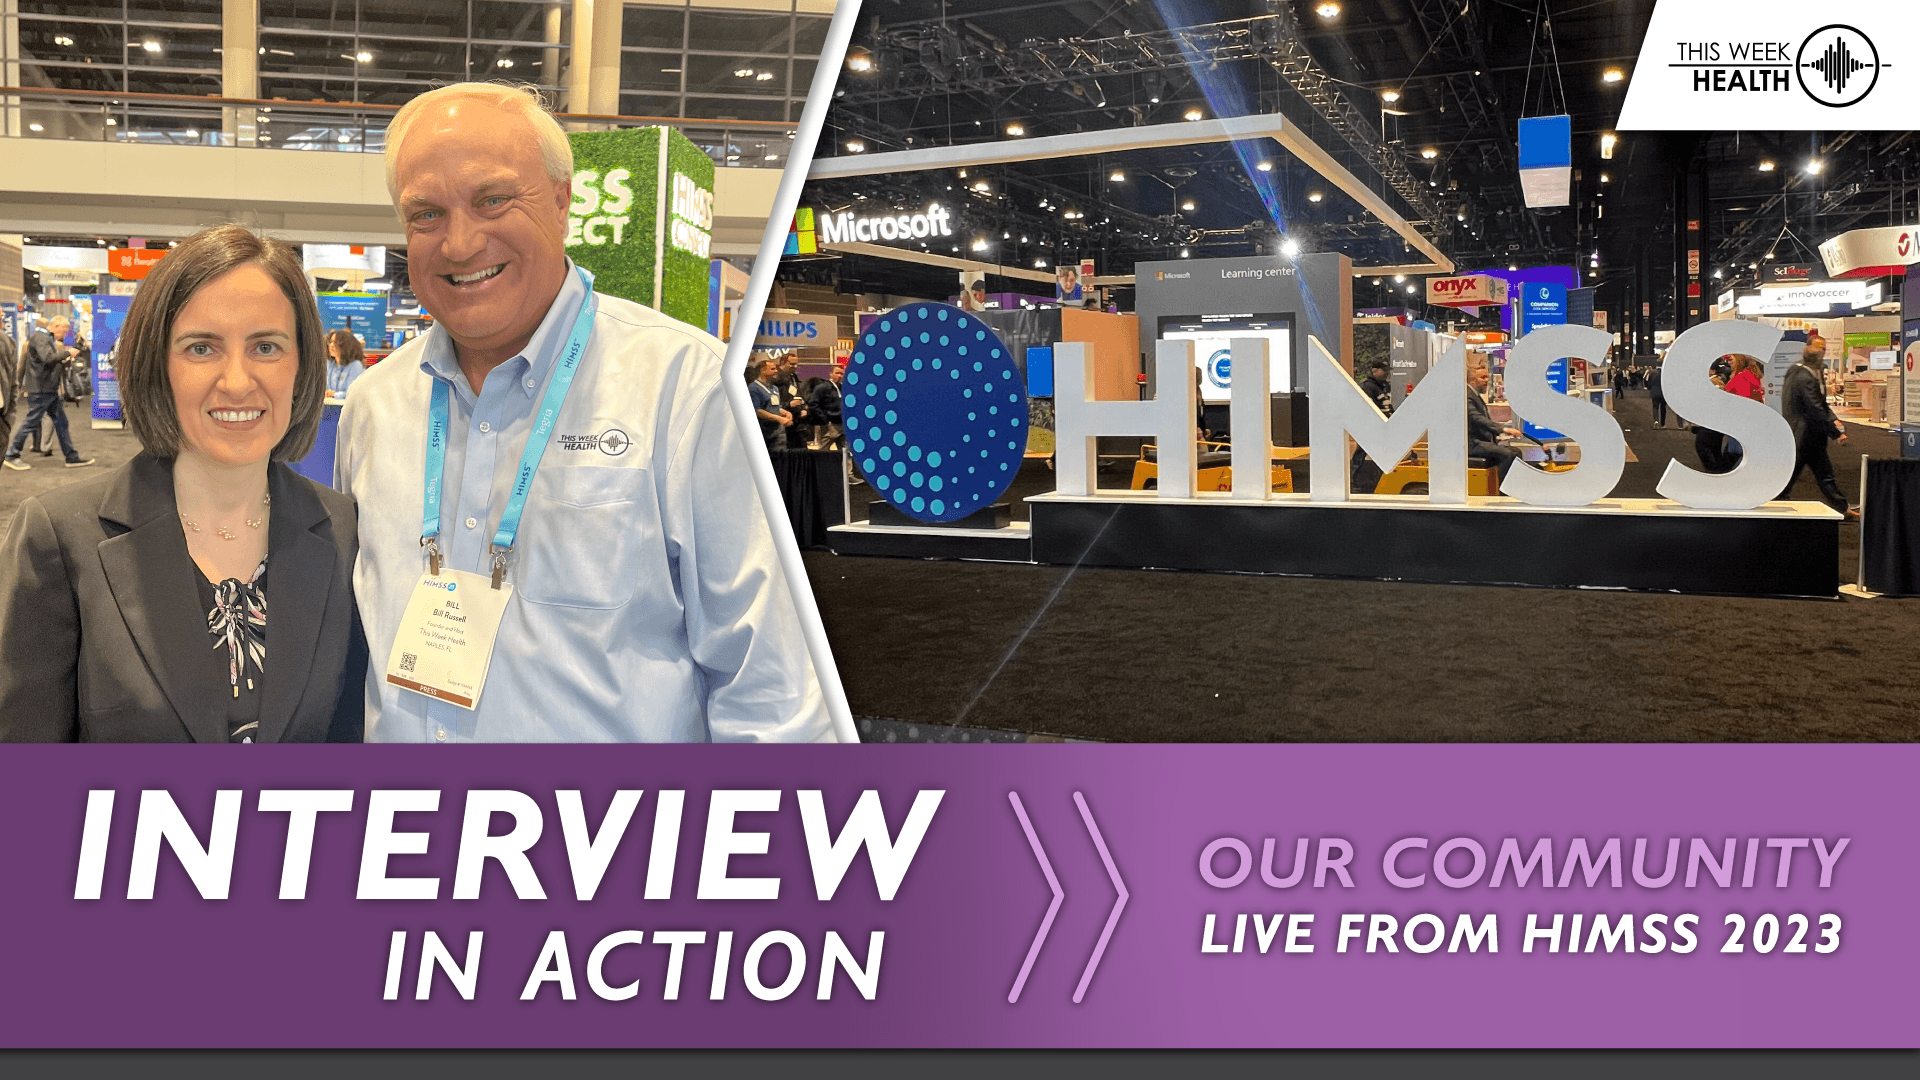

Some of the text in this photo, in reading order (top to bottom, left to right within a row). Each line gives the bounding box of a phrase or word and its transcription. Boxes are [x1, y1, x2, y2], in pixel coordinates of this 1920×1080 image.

[821, 203, 952, 244] Microsoft
[1221, 267, 1296, 279] Learning center
[1433, 278, 1477, 295] onyx
[1788, 289, 1850, 298] innovaccer
[564, 342, 581, 369] HIMSS
[536, 408, 553, 435] Tegria
[1054, 319, 1796, 508] HIMSS
[432, 420, 441, 448] HIMSS
[564, 443, 598, 451] HEALTH
[516, 466, 531, 496] HIMSS
[427, 476, 438, 504] Tegria
[423, 580, 447, 590] HIMSS
[446, 600, 460, 610] BILL
[433, 609, 467, 623] Bill Russell
[420, 628, 466, 646] This Week Health
[420, 685, 438, 696] PRESS
